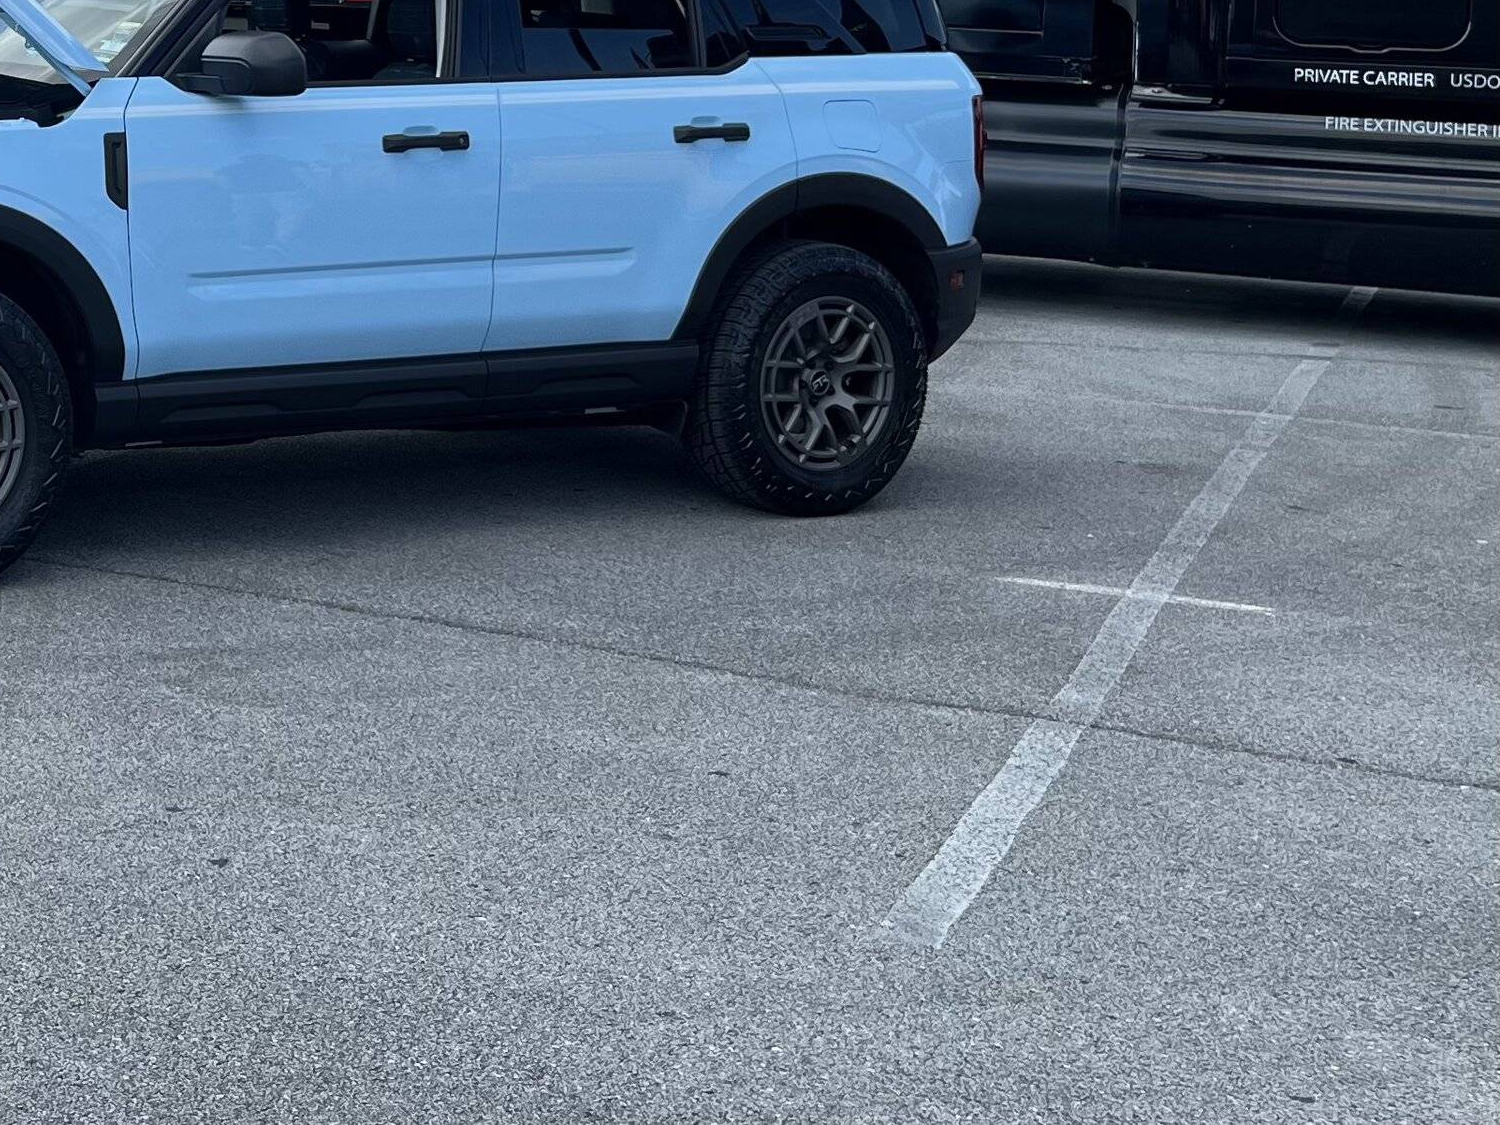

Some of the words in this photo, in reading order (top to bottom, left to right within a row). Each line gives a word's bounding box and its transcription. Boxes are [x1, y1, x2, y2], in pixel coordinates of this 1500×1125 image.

[1294, 68, 1360, 85] PRIVATE
[1363, 71, 1435, 88] CARRIER
[1325, 117, 1359, 131] FIRE
[1363, 118, 1488, 138] EXTINGUISHER
